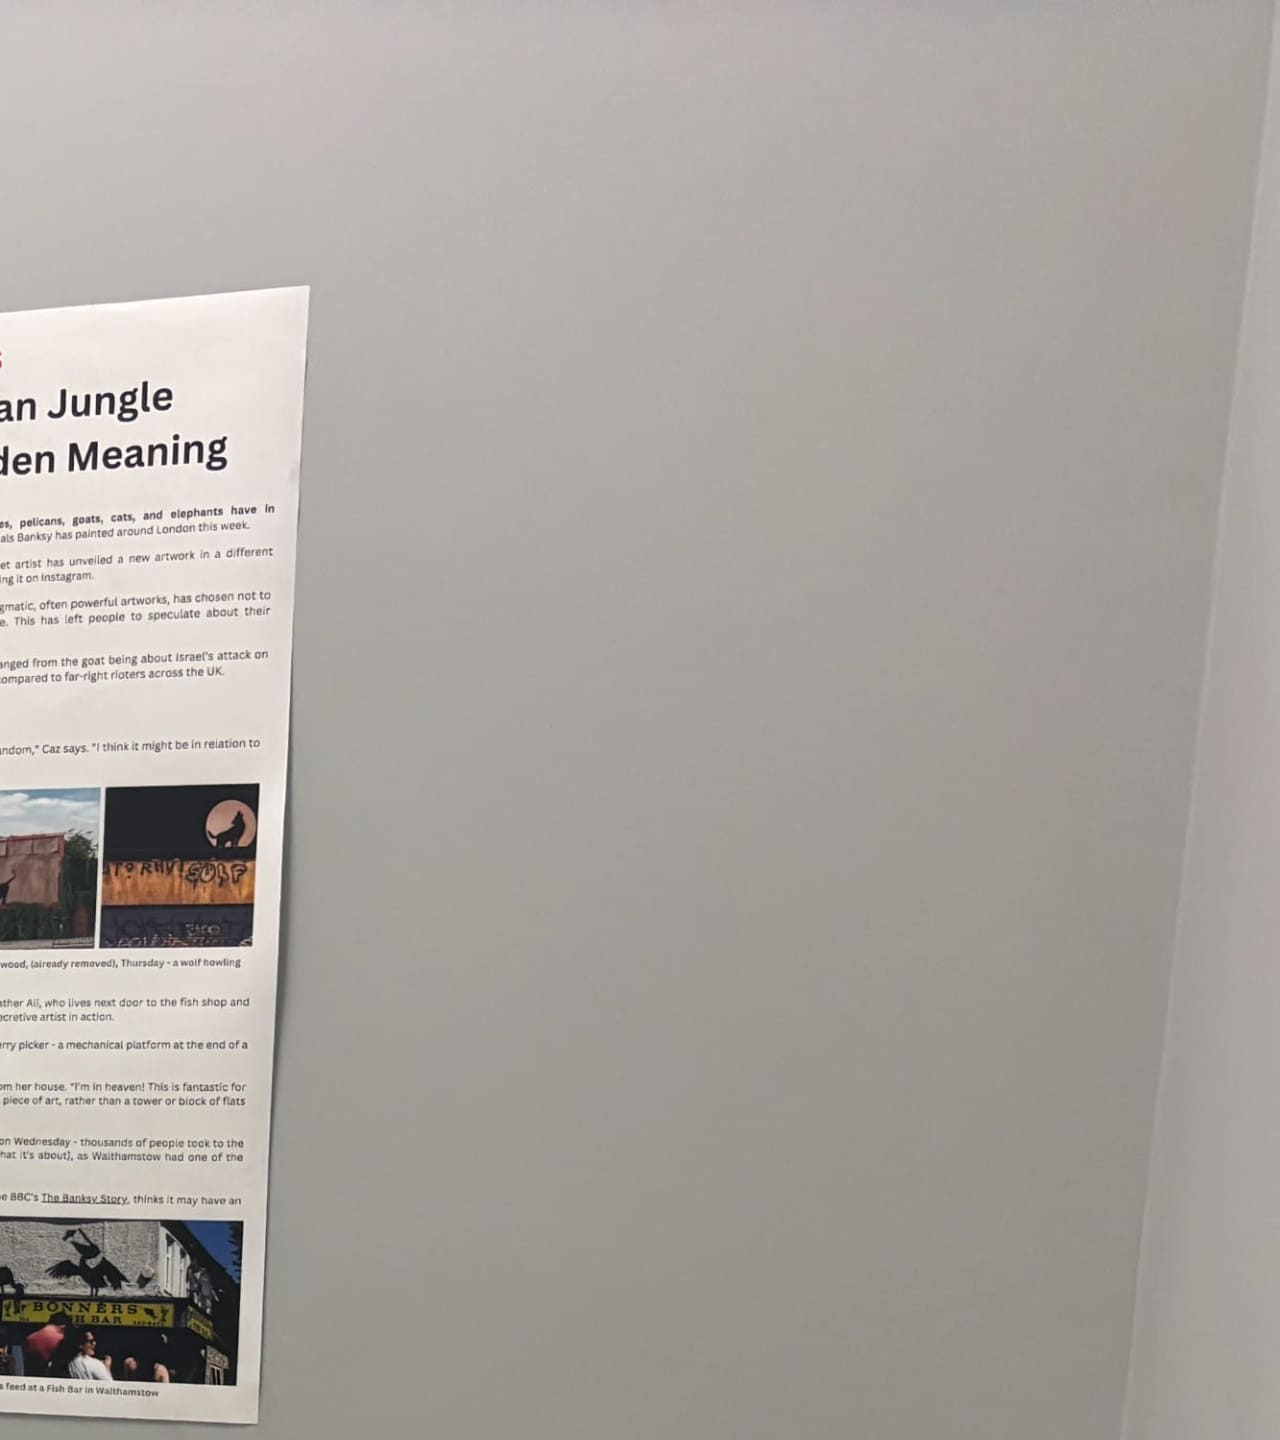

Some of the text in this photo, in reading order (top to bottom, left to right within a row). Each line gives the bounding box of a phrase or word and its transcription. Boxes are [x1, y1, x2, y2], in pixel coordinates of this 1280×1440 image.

[46, 380, 174, 424] Jungle
[67, 433, 229, 473] Meaning
[18, 516, 66, 531] pelicans,
[71, 514, 104, 528] goats,
[110, 512, 137, 523] cats,
[142, 509, 164, 521] and
[169, 506, 224, 521] elephants
[230, 504, 258, 516] have
[264, 503, 276, 514] in
[16, 531, 54, 544] Banksy
[54, 530, 74, 541] has
[74, 527, 115, 542] painted
[115, 524, 155, 538] around
[155, 523, 197, 536] London
[197, 521, 219, 533] this
[220, 519, 251, 531] week.
[14, 558, 43, 570] artist
[46, 557, 65, 569] has
[68, 554, 114, 568] unveiled
[128, 554, 151, 564] new
[153, 549, 196, 563] artwork
[199, 549, 211, 560] in
[225, 546, 274, 559] different
[15, 574, 24, 584] it
[24, 574, 40, 584] on
[40, 571, 95, 584] Instagram.
[5, 1381, 27, 1392] feed
[27, 1383, 38, 1393] at
[46, 1383, 66, 1394] Fish
[66, 1384, 84, 1394] Bar
[84, 1385, 95, 1395] in
[95, 1386, 160, 1398] Walthamstow
